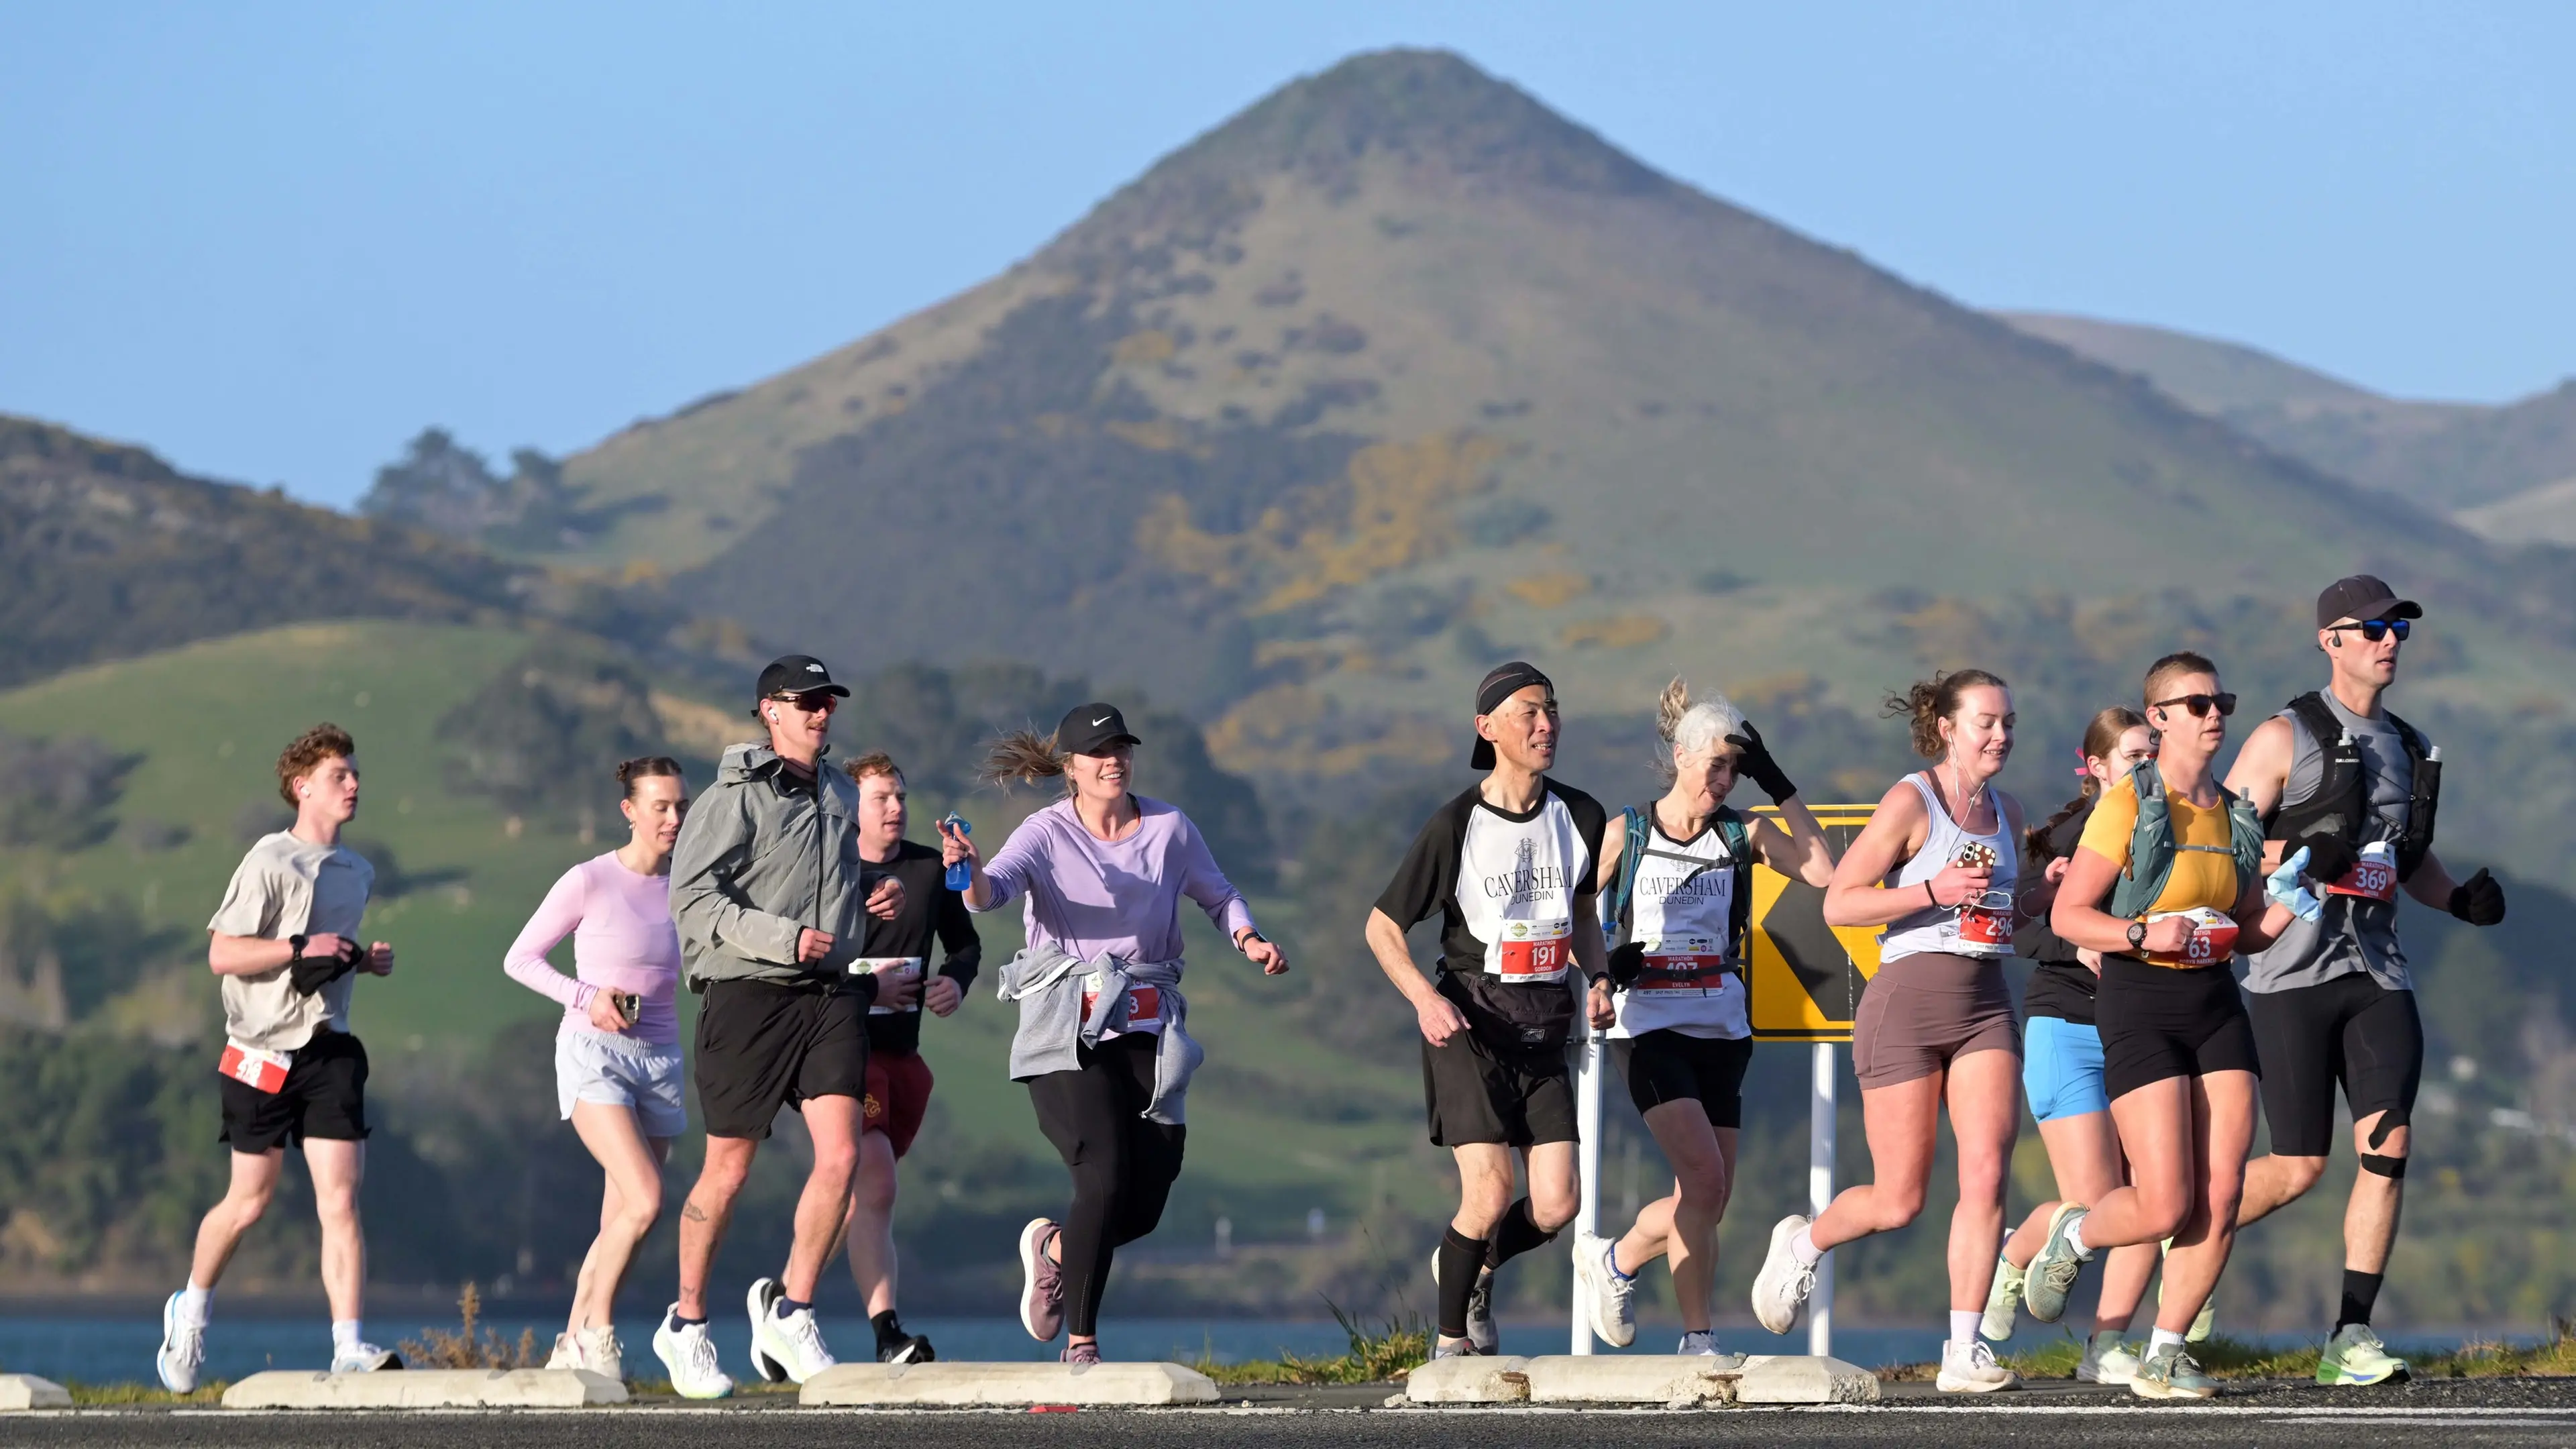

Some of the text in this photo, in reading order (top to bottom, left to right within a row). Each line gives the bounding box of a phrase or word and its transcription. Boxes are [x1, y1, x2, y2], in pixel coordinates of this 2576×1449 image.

[1485, 865, 1572, 898] CAVERSHAM
[1640, 877, 1725, 896] CAVERSHAM
[2356, 867, 2387, 890] 369
[1511, 890, 1554, 905] DUNEDIN
[1659, 896, 1704, 905] DUNEDIN
[1986, 916, 2012, 936] 296
[1532, 946, 1556, 966] 191
[2189, 936, 2211, 958] 63
